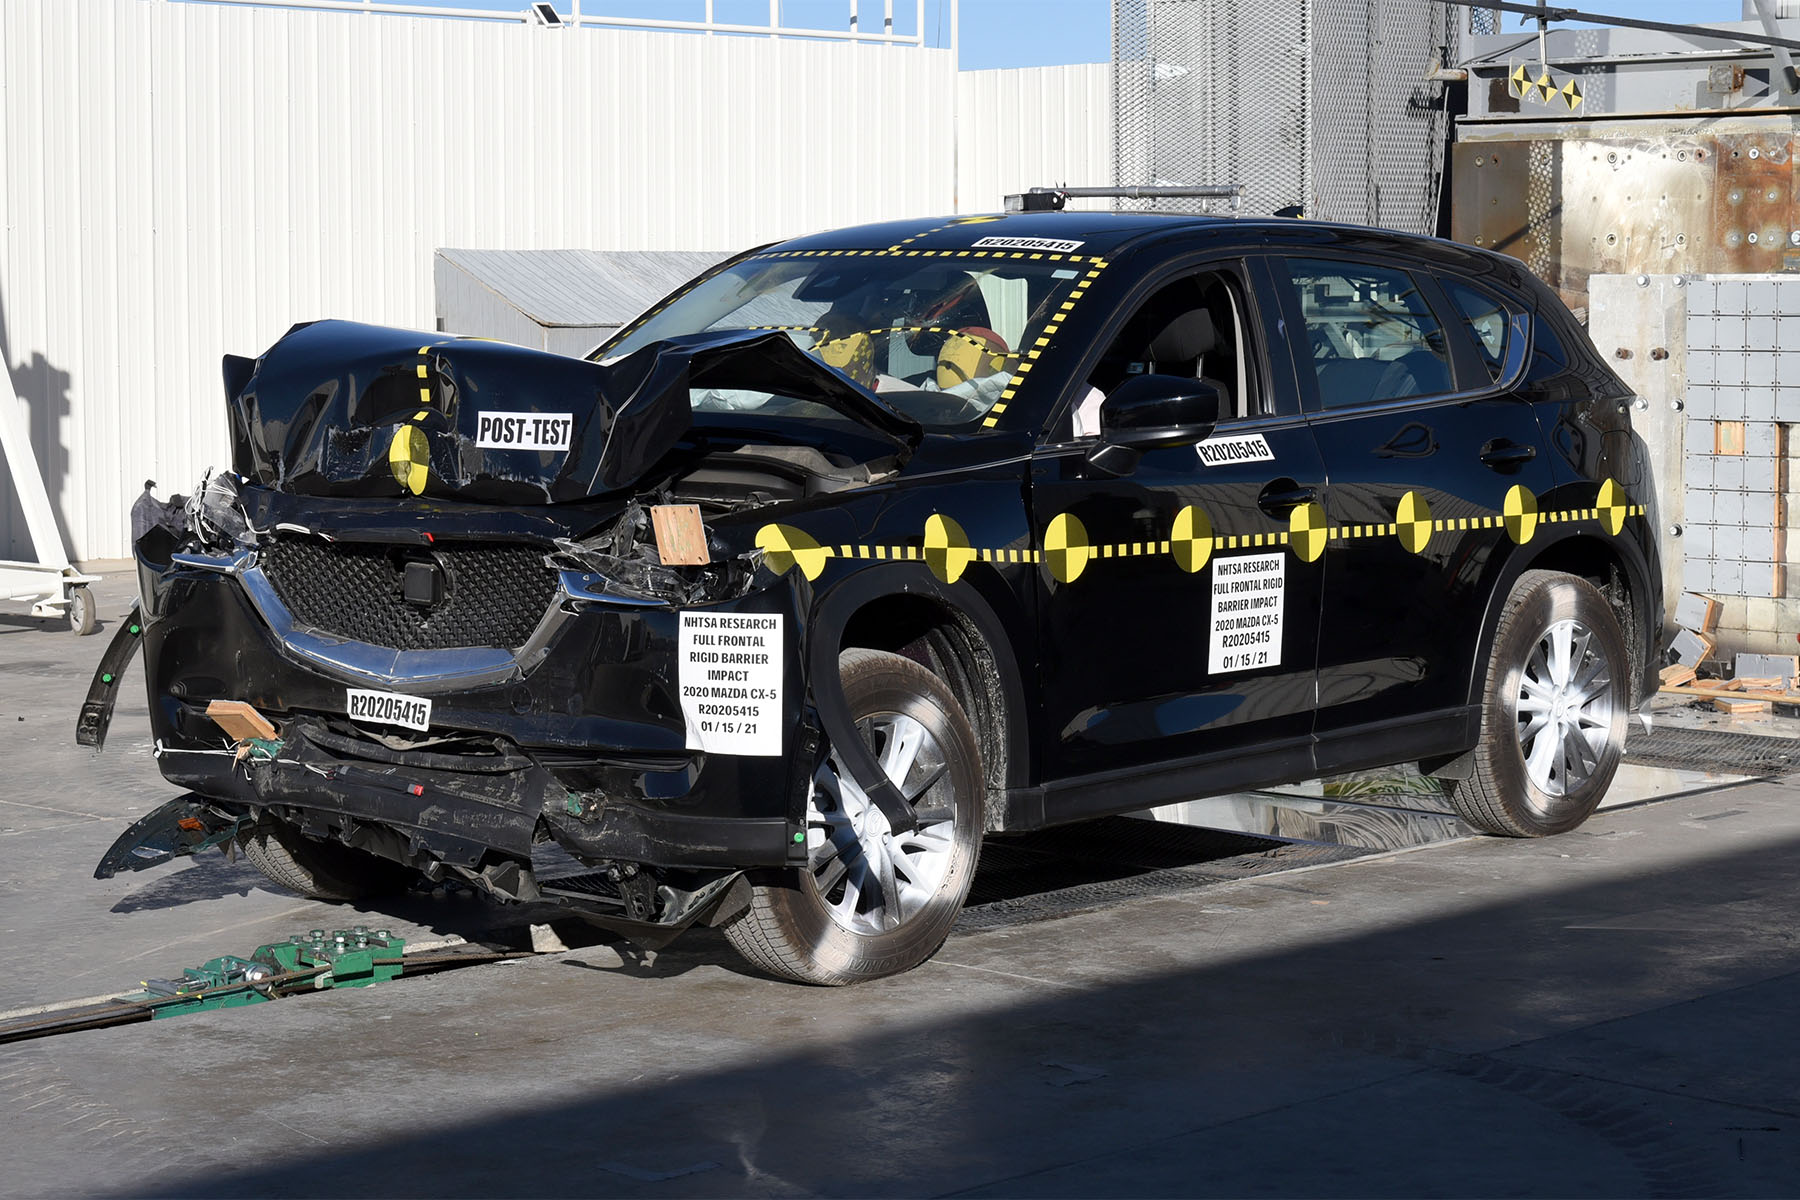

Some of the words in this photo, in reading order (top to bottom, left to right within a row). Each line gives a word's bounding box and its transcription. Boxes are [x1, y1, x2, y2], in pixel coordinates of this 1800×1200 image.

[979, 239, 1076, 250] R20205415
[479, 417, 571, 445] POST-TEST
[1198, 440, 1269, 462] R20205415
[1218, 563, 1242, 576] NHTSA
[1243, 560, 1279, 573] RESEARCH
[1214, 582, 1229, 595] FULL
[1231, 579, 1262, 593] FRONTAL
[1263, 577, 1283, 590] RIGID
[1218, 599, 1249, 613] BARRIER
[1250, 596, 1278, 610] IMPACT
[684, 617, 717, 628] NHTSA
[720, 618, 777, 630] RESEARCH
[1215, 618, 1235, 632] 2020
[1236, 615, 1260, 629] MAZDA
[1262, 613, 1279, 626] CX-5
[693, 634, 716, 646] FULL
[718, 635, 765, 647] FRONTAL
[1222, 630, 1270, 648] R20205415
[690, 652, 719, 663] RIGID
[721, 653, 769, 664] BARRIER
[1223, 655, 1233, 669] 01
[1241, 653, 1250, 666] 15
[1258, 651, 1268, 664] 21
[708, 670, 749, 681] IMPACT
[683, 686, 709, 697] 2020
[711, 687, 748, 699] MAZDA
[750, 688, 777, 700] CX-5
[351, 695, 427, 726] R20205415
[698, 704, 760, 716] R20205415
[701, 720, 712, 732] 01
[722, 722, 734, 733] 15
[744, 723, 757, 734] 21
